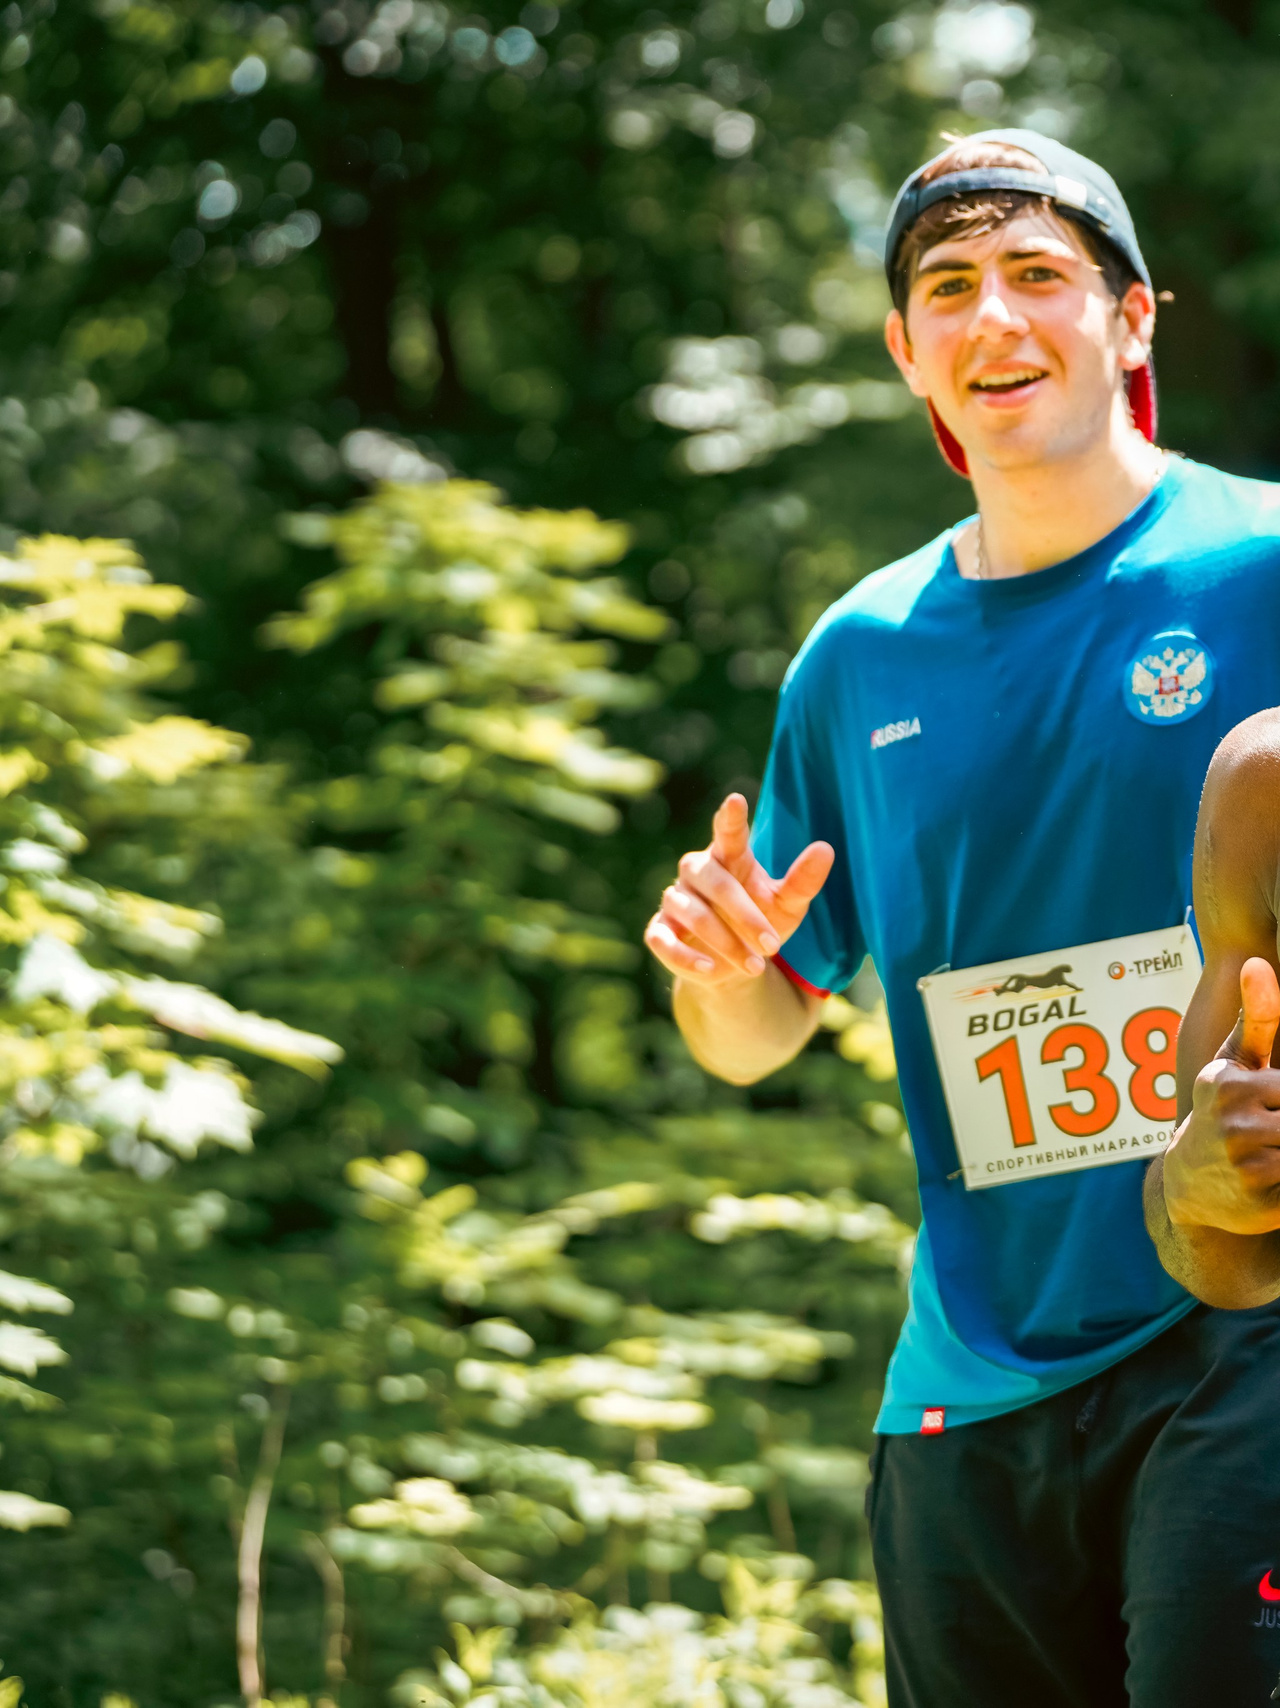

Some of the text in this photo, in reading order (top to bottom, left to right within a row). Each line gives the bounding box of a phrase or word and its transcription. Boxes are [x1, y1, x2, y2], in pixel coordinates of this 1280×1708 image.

[870, 716, 922, 750] RUSSIA
[967, 996, 1087, 1037] BOGAL
[975, 1006, 1184, 1149] 138
[987, 1129, 1175, 1173] СПОРТИВНЫЙ МАРАФО
